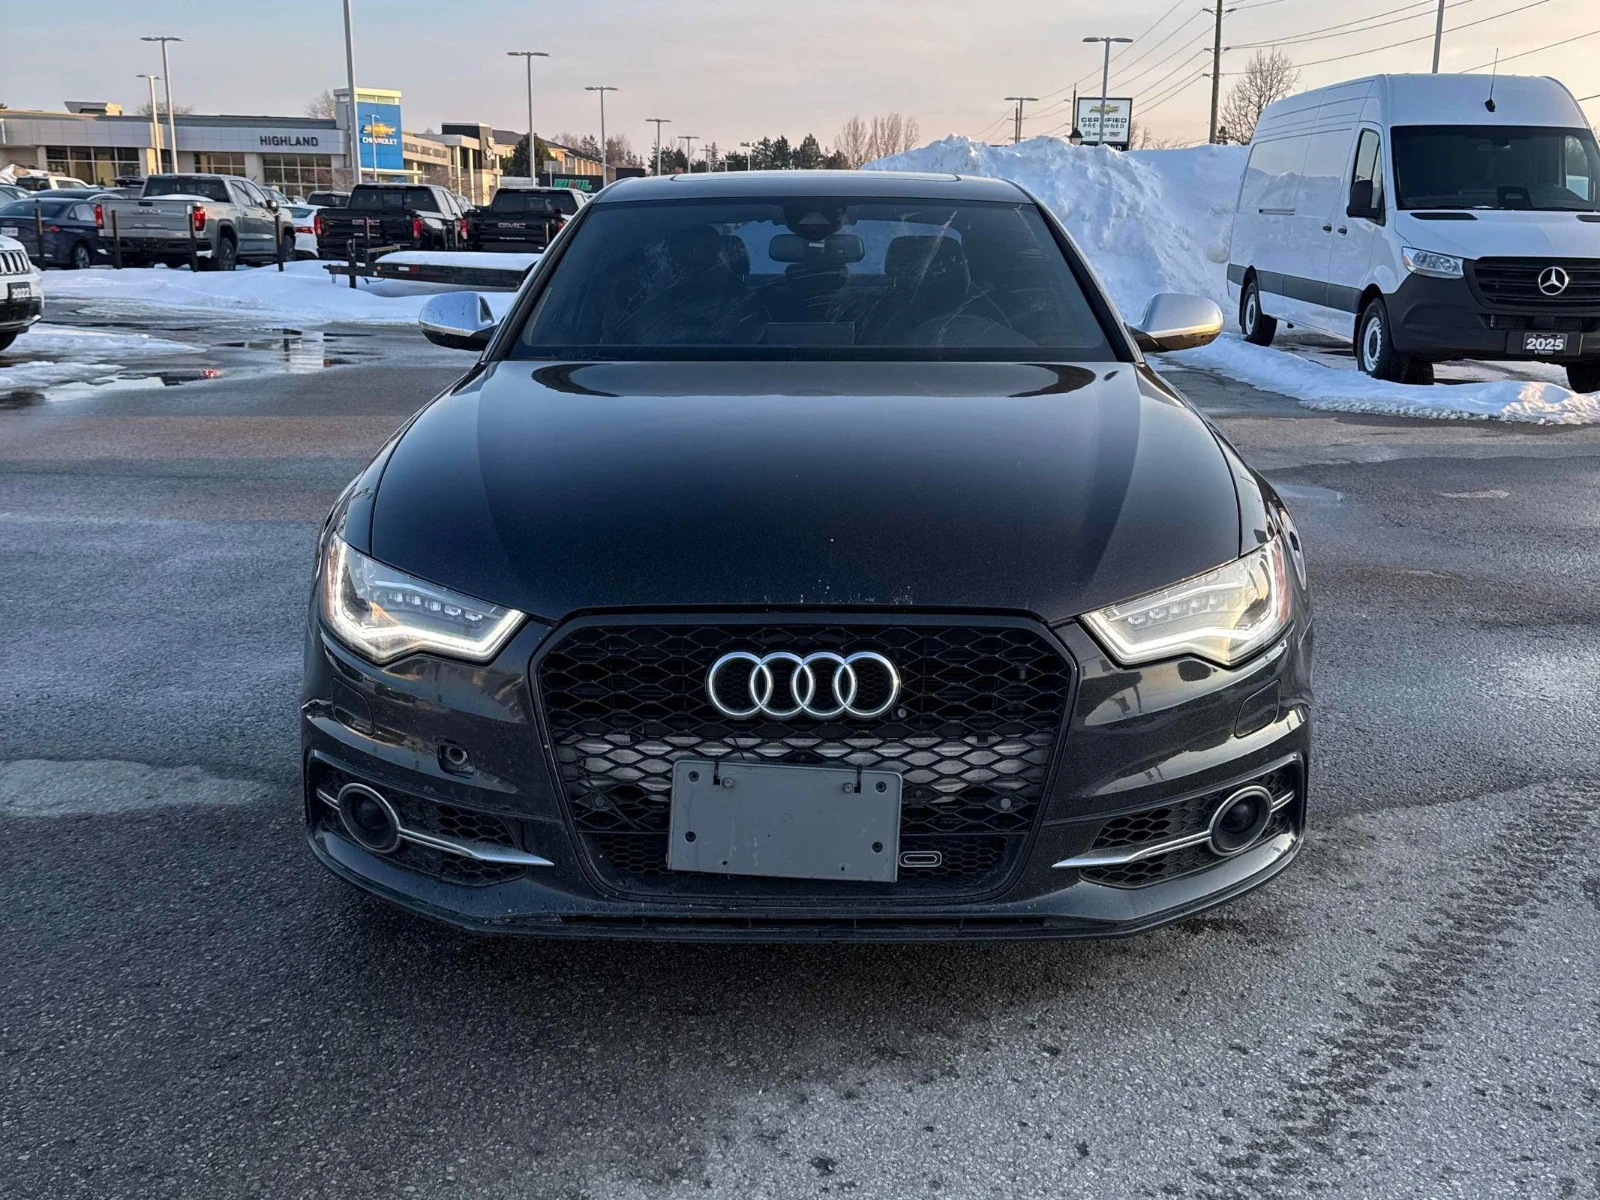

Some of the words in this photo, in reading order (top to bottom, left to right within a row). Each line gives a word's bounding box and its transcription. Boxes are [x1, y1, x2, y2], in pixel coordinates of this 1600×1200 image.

[260, 136, 318, 147] HIGHLAND
[362, 137, 397, 145] CHVROLET
[1525, 337, 1564, 350] 2025
